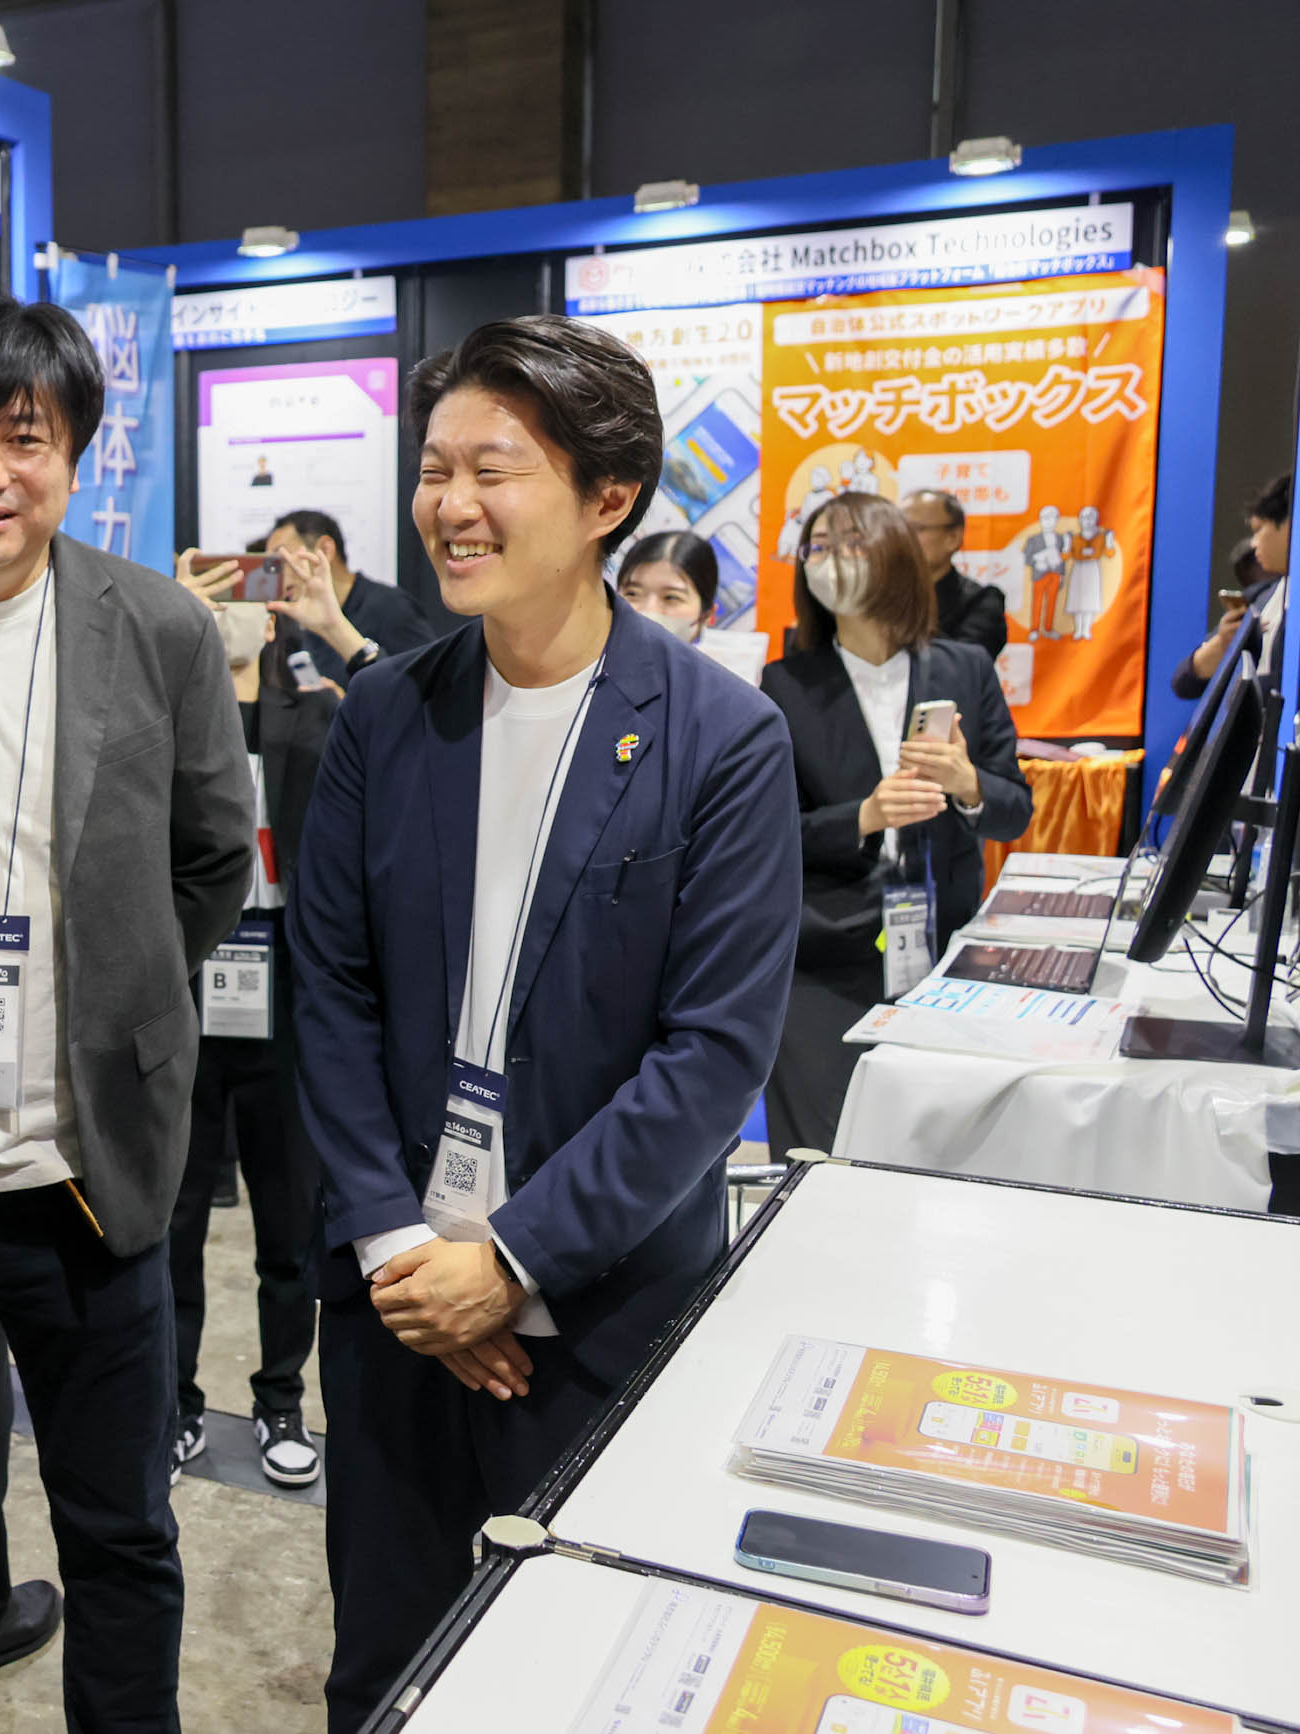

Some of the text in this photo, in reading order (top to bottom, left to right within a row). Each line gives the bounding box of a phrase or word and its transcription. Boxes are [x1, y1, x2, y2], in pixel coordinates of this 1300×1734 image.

[791, 236, 917, 268] Matchbox
[929, 214, 1114, 257] Technologies
[772, 362, 1148, 440] マッチボックス
[213, 972, 227, 989] B
[459, 1080, 499, 1102] CEATEC
